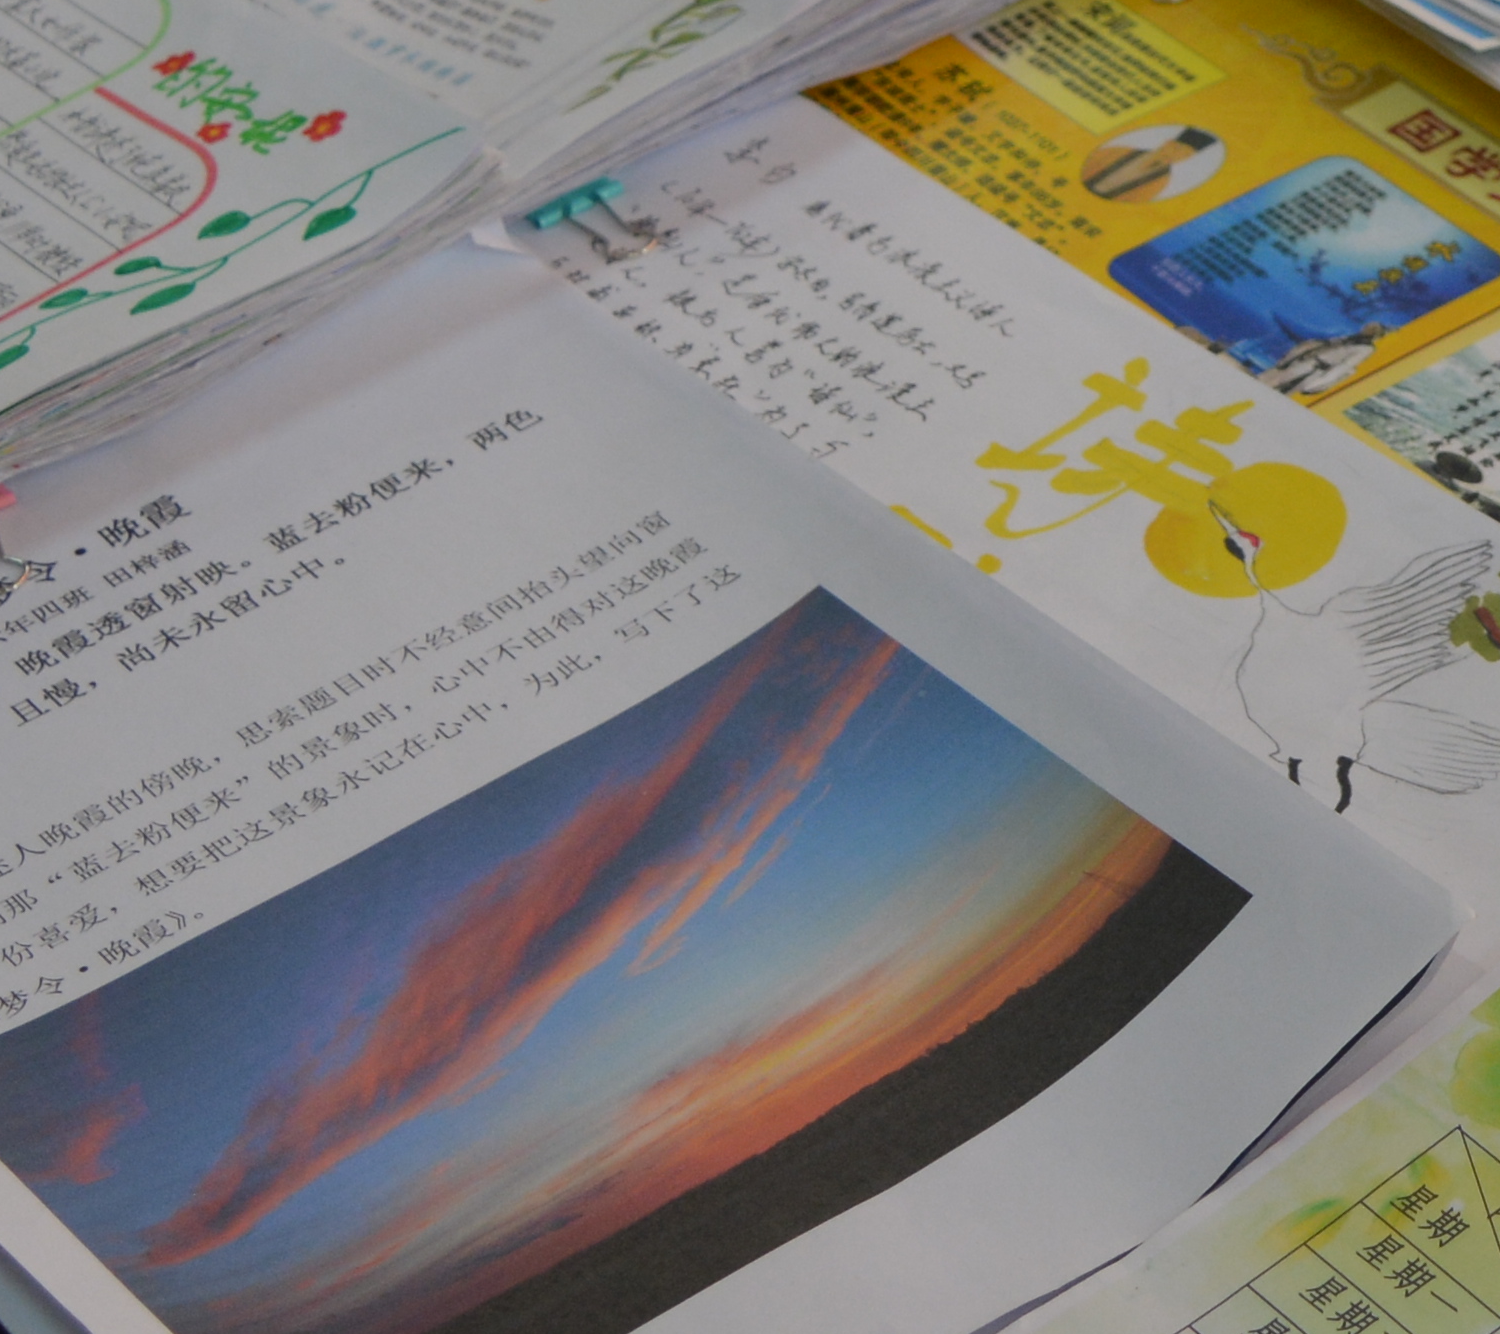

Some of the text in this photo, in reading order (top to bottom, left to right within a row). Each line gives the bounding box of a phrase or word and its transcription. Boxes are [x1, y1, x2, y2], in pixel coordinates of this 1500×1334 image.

[1387, 1183, 1472, 1249] 星期
[1354, 1233, 1460, 1314] 星期一
